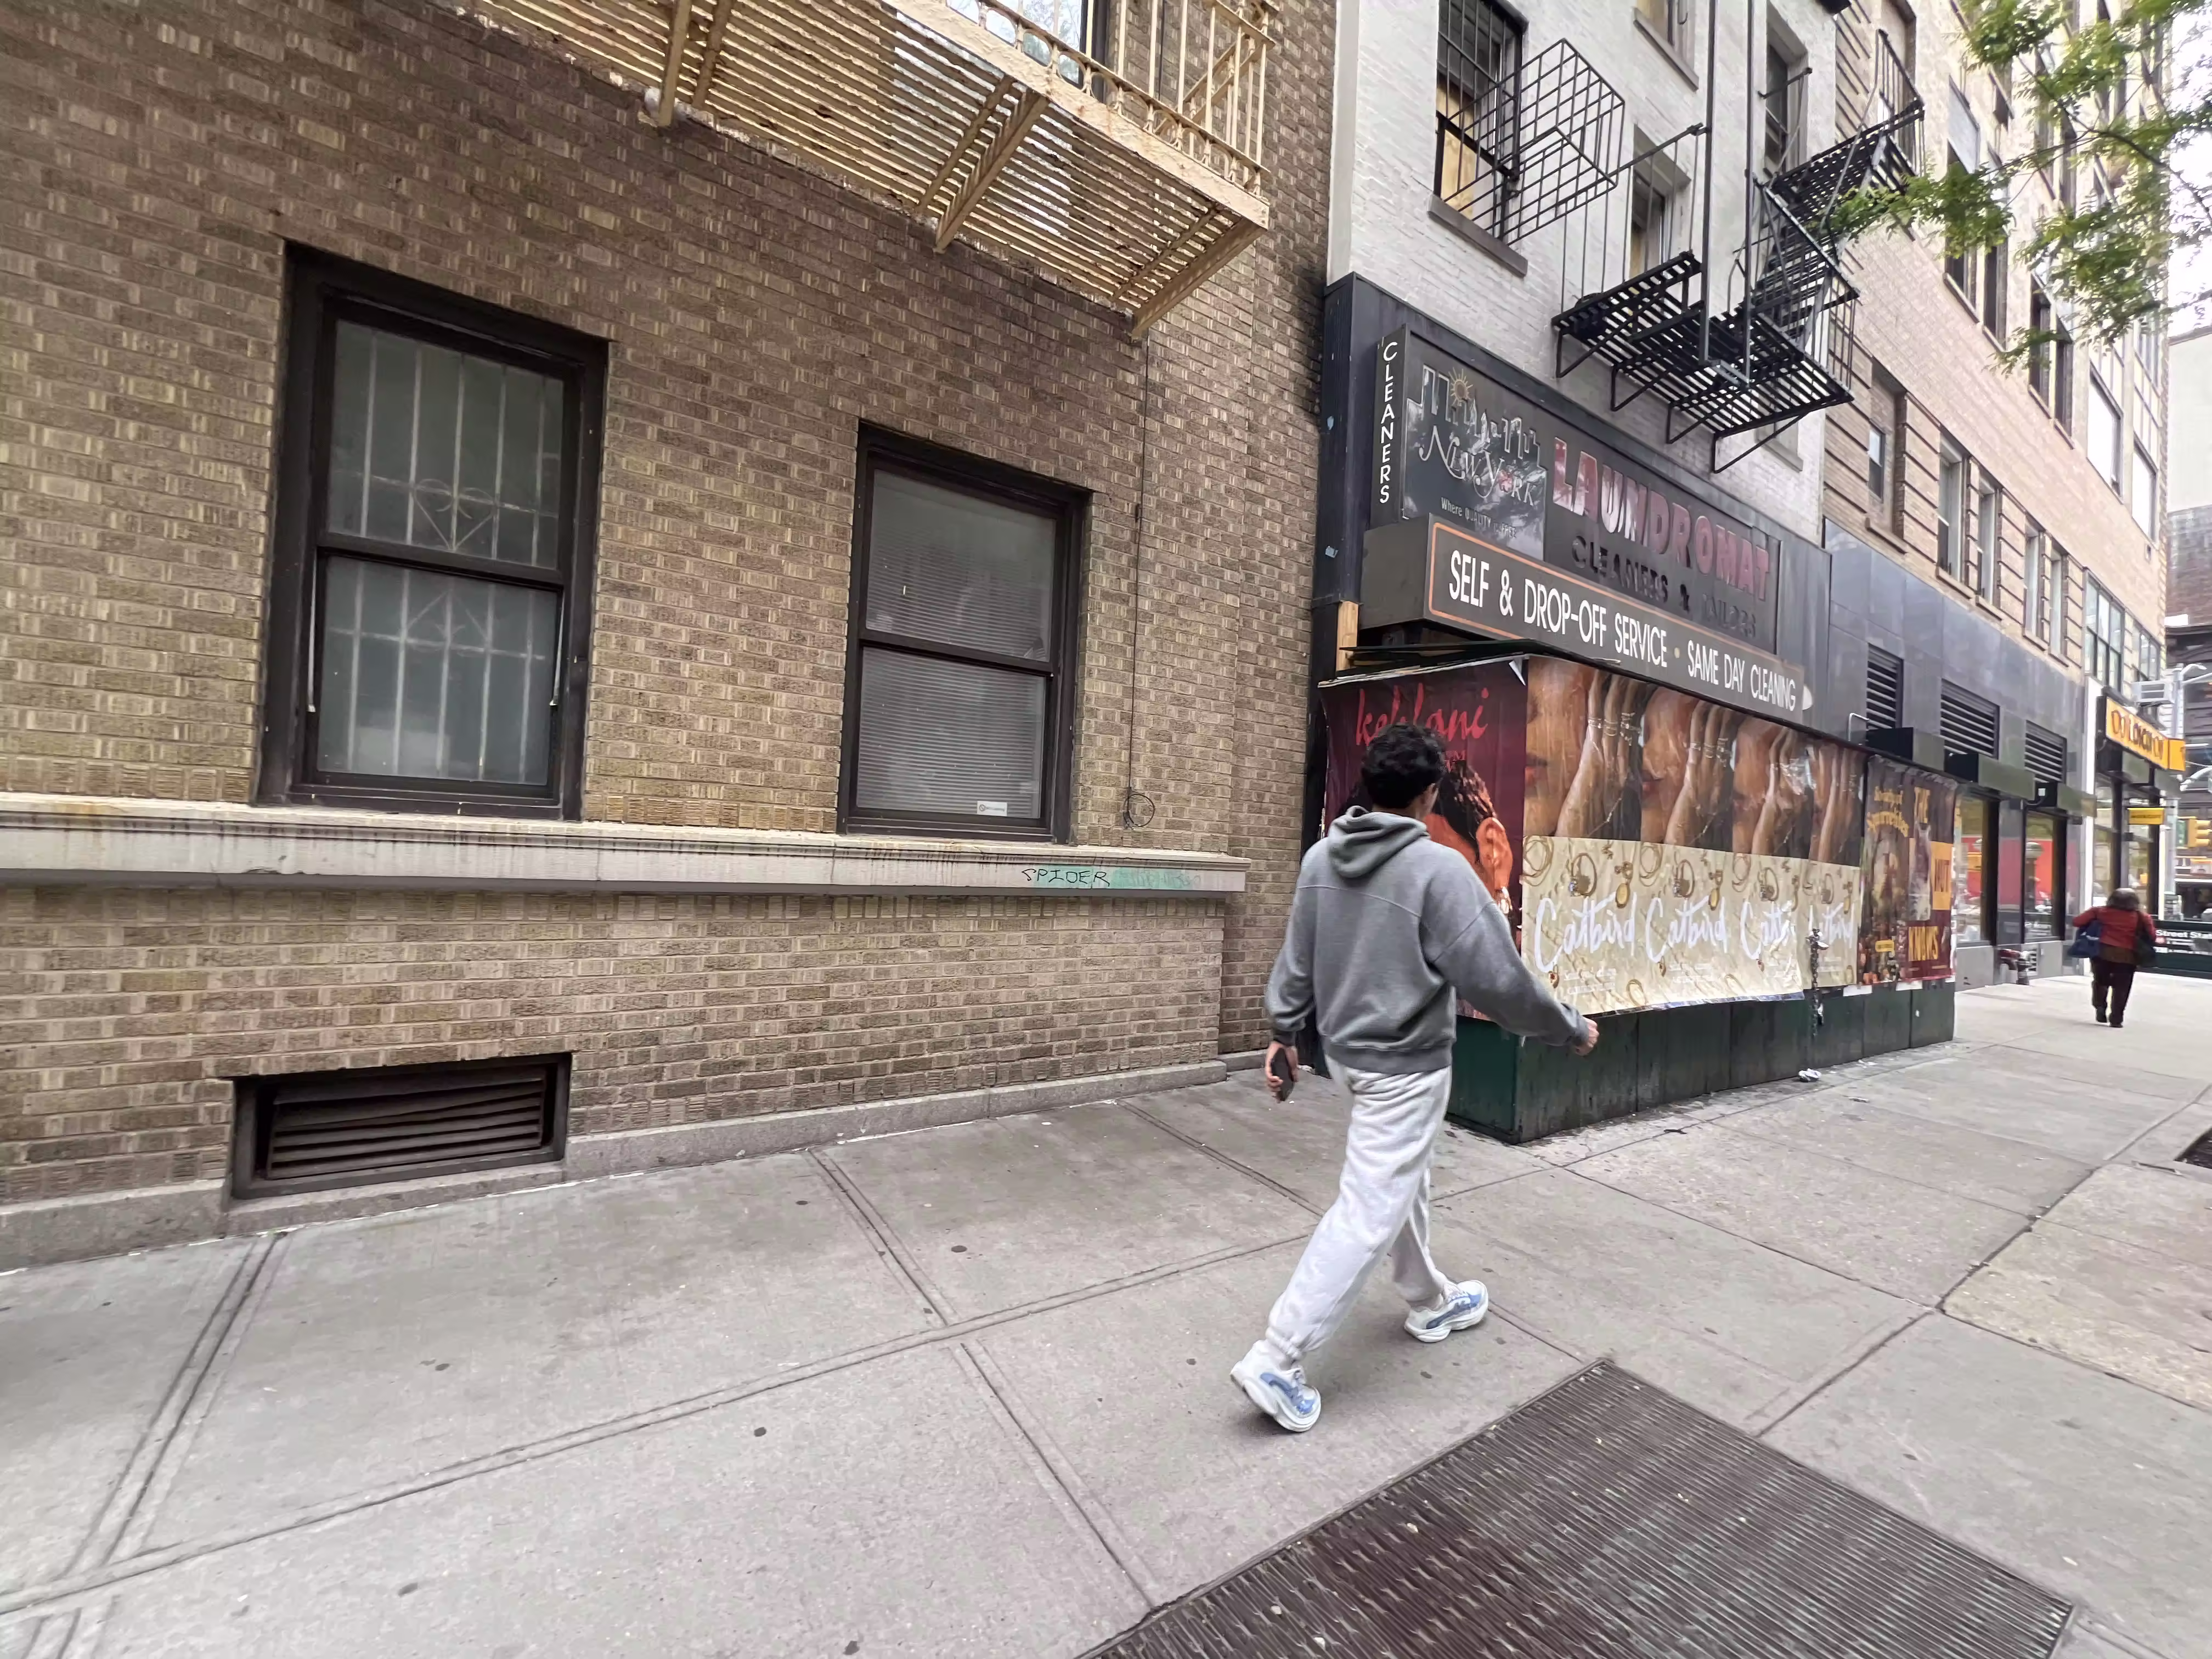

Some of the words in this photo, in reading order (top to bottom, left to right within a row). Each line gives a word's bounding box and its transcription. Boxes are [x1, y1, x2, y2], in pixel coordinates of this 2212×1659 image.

[1379, 341, 1398, 504] CLEANERS
[1441, 496, 1463, 516] Where
[1552, 437, 1769, 602] LAUNDROMAT
[1572, 535, 1668, 603] CLEANERS
[1449, 550, 1490, 608] SELF
[1499, 569, 1514, 617] &
[1524, 578, 1607, 647] DROP-OFF
[1615, 612, 1668, 668] SERVICE
[1688, 640, 1719, 685] SAME
[1724, 654, 1745, 693] DAY
[1750, 664, 1796, 712] CLEANING
[1022, 868, 1110, 887] SPIDER
[1535, 891, 1637, 973] Catbird
[1646, 895, 1728, 963] Catbird
